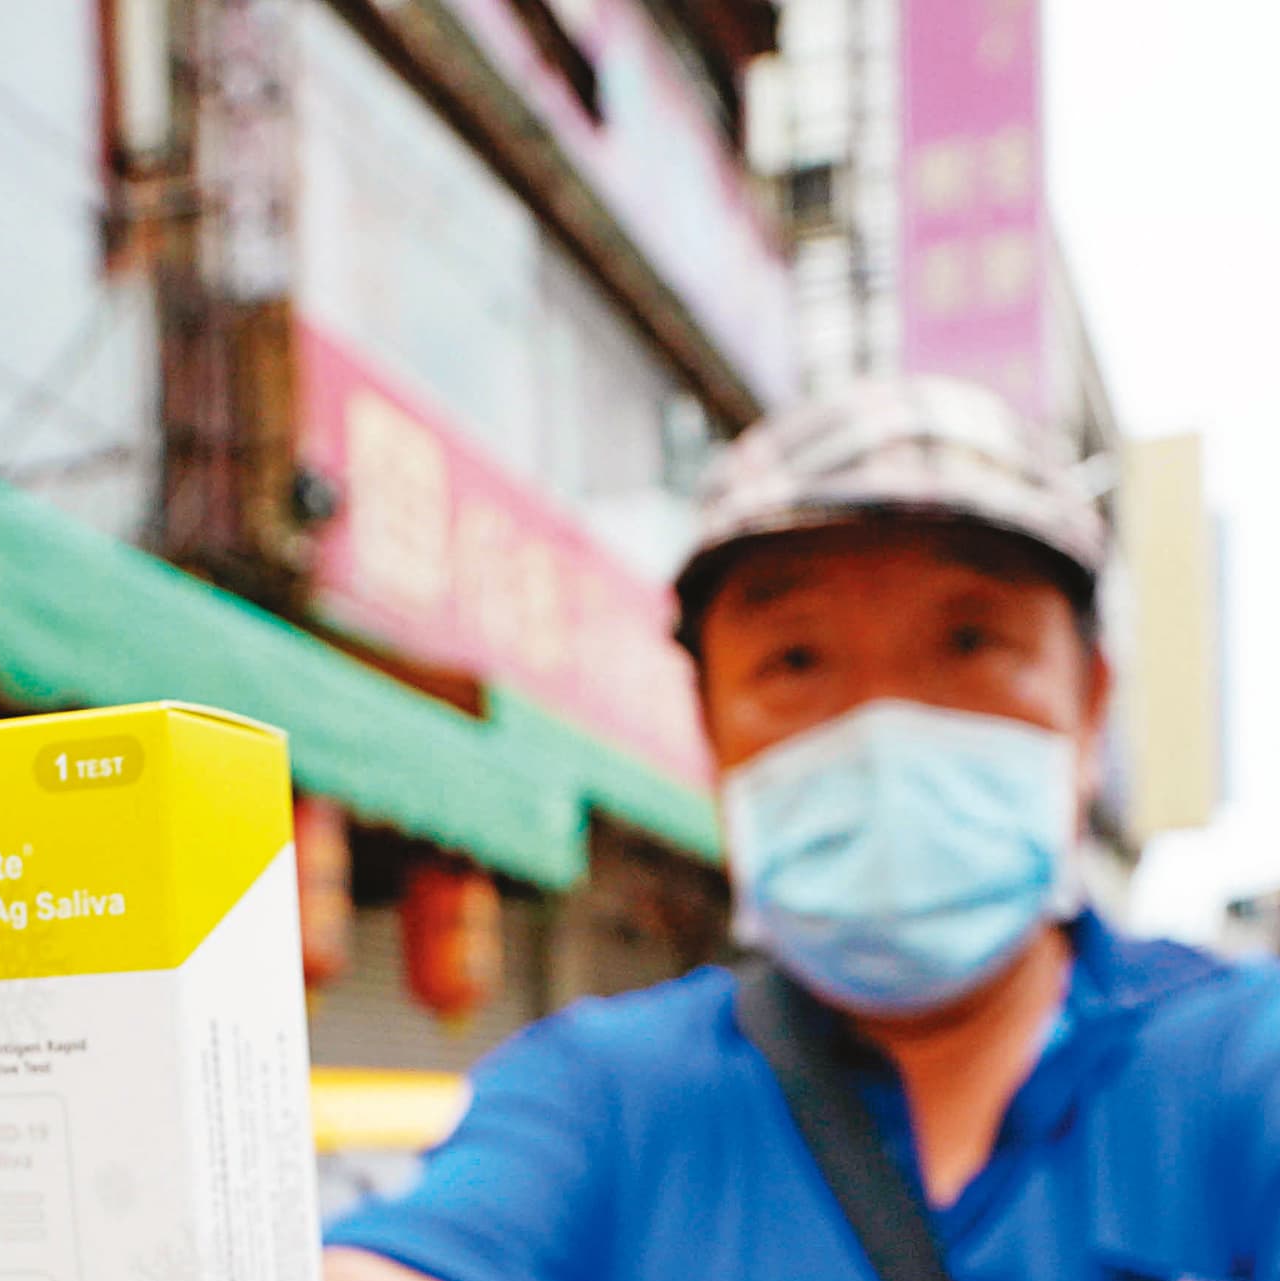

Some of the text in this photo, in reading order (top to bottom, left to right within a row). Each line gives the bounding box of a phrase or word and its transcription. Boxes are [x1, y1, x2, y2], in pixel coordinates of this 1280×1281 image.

[54, 753, 125, 782] 1 TEST
[35, 890, 126, 922] Saliva
